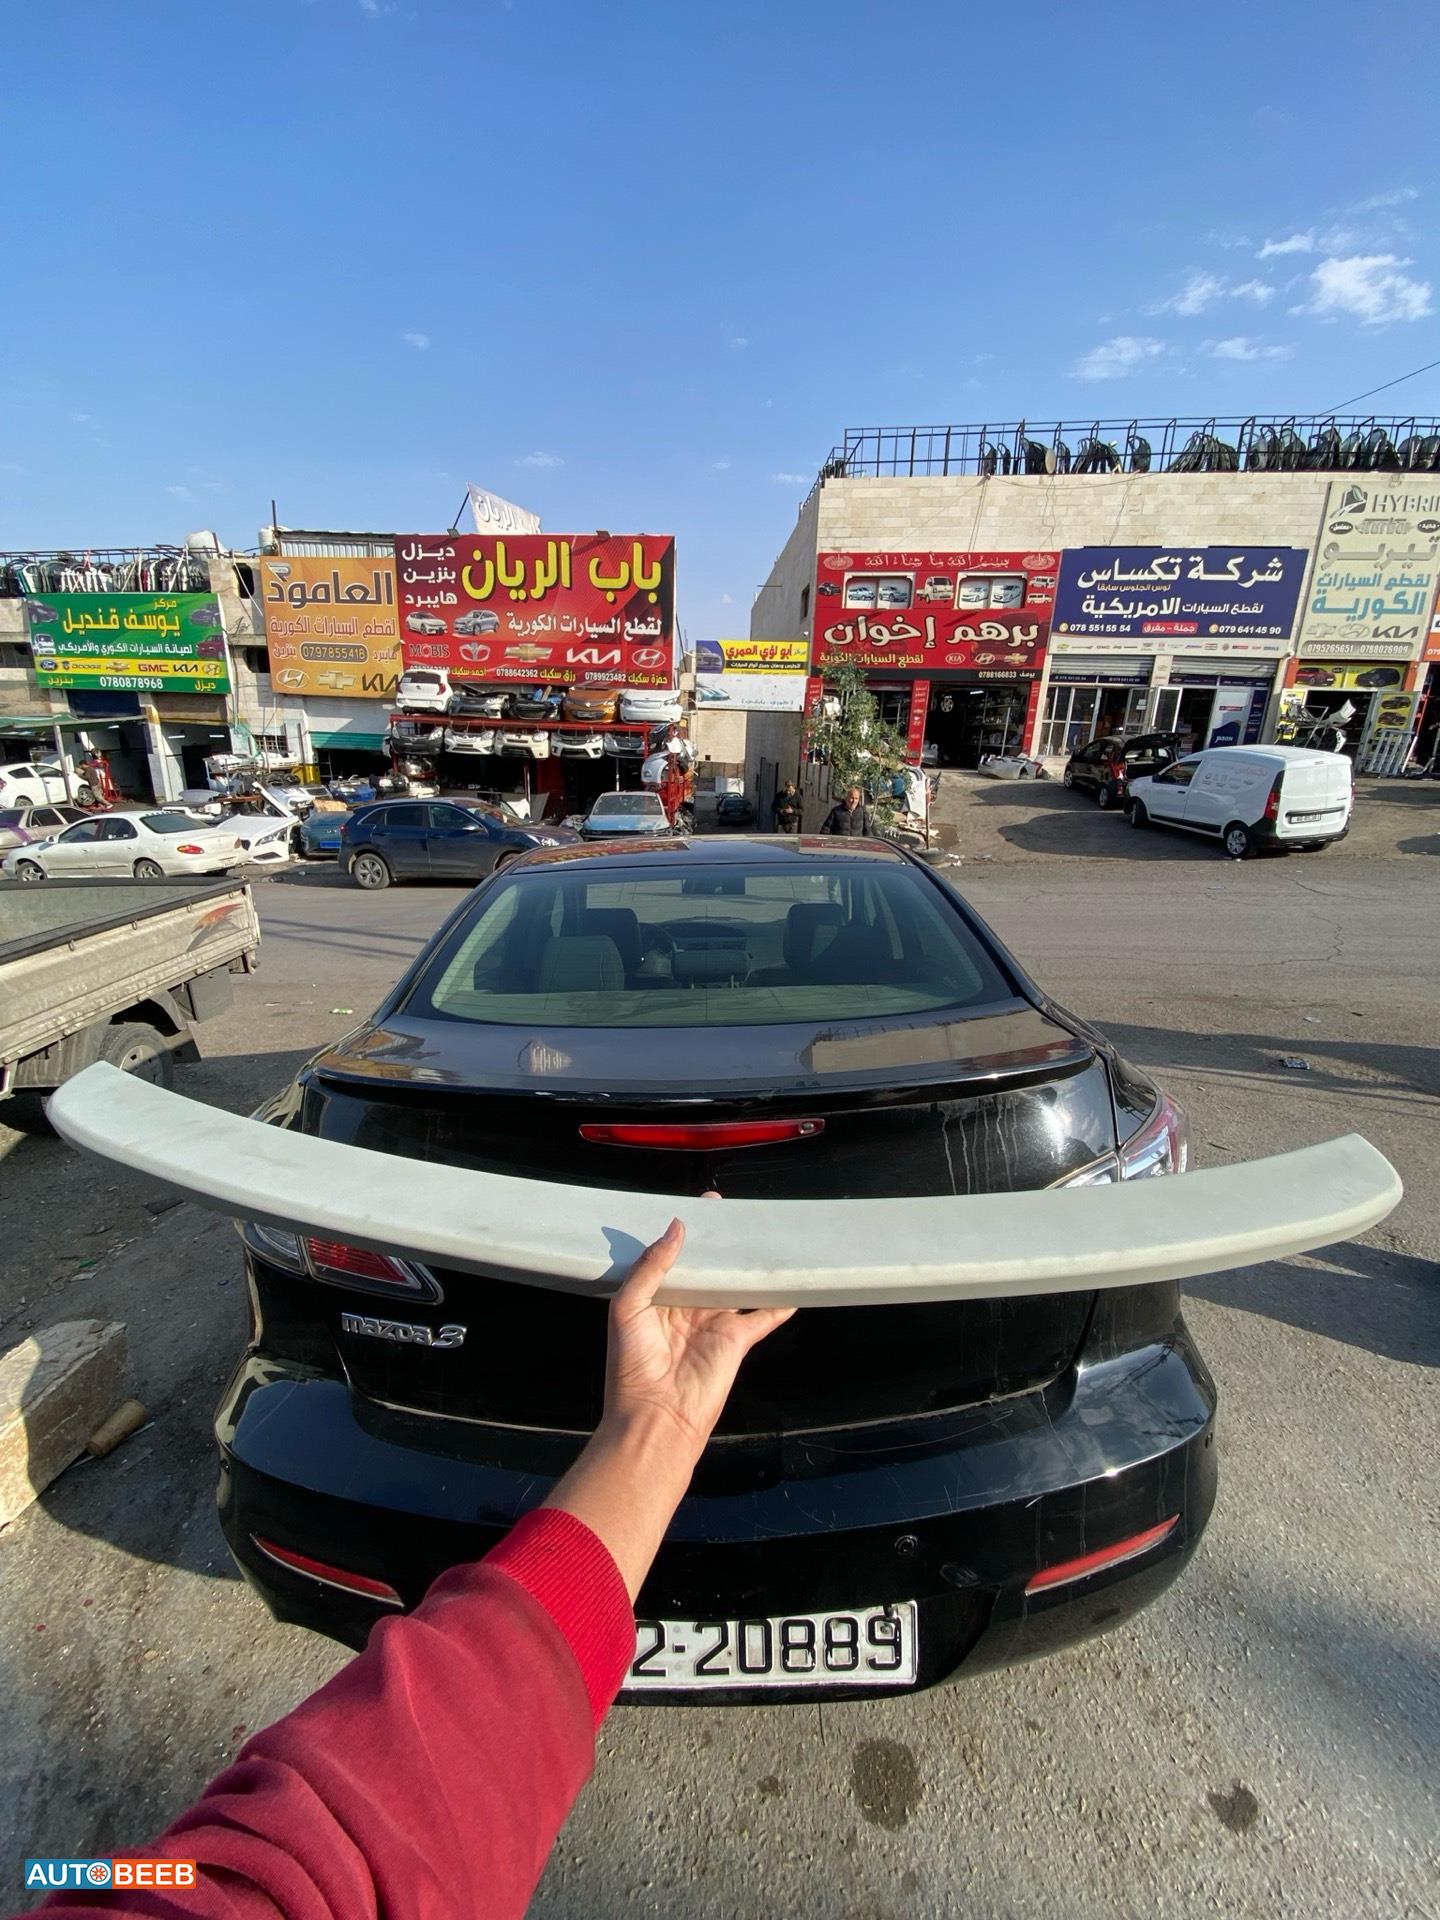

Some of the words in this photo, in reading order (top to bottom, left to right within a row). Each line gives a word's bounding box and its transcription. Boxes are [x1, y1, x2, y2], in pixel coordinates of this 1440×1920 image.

[402, 542, 456, 560] ديزل
[403, 565, 456, 584] بنزين
[461, 541, 571, 601] الريان
[588, 541, 662, 603] باب
[1077, 555, 1183, 588] تكساس
[1187, 555, 1284, 588] شركة
[267, 570, 394, 610] العامود
[1316, 572, 1383, 591] السيارات
[1384, 573, 1431, 591] لقطع
[154, 598, 177, 611] مركز
[405, 590, 458, 608] هايبرد
[1081, 595, 1181, 619] الامريكية
[1182, 601, 1229, 615] السيارات
[1311, 588, 1427, 622] الكورية
[1230, 602, 1264, 615] لقطع
[63, 607, 120, 635] قنديل
[124, 608, 180, 638] يوسف
[270, 616, 311, 638] الكورية
[314, 617, 358, 638] السيارات
[362, 618, 396, 639] لقطع
[507, 612, 556, 636] الكورية
[560, 615, 621, 640] السيارات
[623, 618, 663, 642] لقطع
[1070, 624, 1087, 632] 078
[1088, 624, 1105, 632] 551
[1119, 625, 1131, 633] 54
[1173, 623, 1196, 632] جملة
[1219, 625, 1237, 633] 079
[1237, 626, 1254, 634] 641
[1269, 626, 1282, 635] 90
[823, 615, 937, 649] إخوان
[946, 621, 1039, 648] برهم
[101, 642, 128, 655] الكوري
[129, 642, 163, 655] السيارات
[164, 644, 193, 657] لصيانة
[302, 646, 366, 660] 0797855418
[409, 644, 449, 659] MOBIS
[725, 645, 758, 660] العمري
[780, 644, 793, 660] أبو
[899, 655, 924, 668] لقطع
[947, 655, 963, 663] KIA
[138, 664, 169, 673] GMC
[100, 676, 164, 689] 0780878968
[194, 680, 216, 691] ديزل
